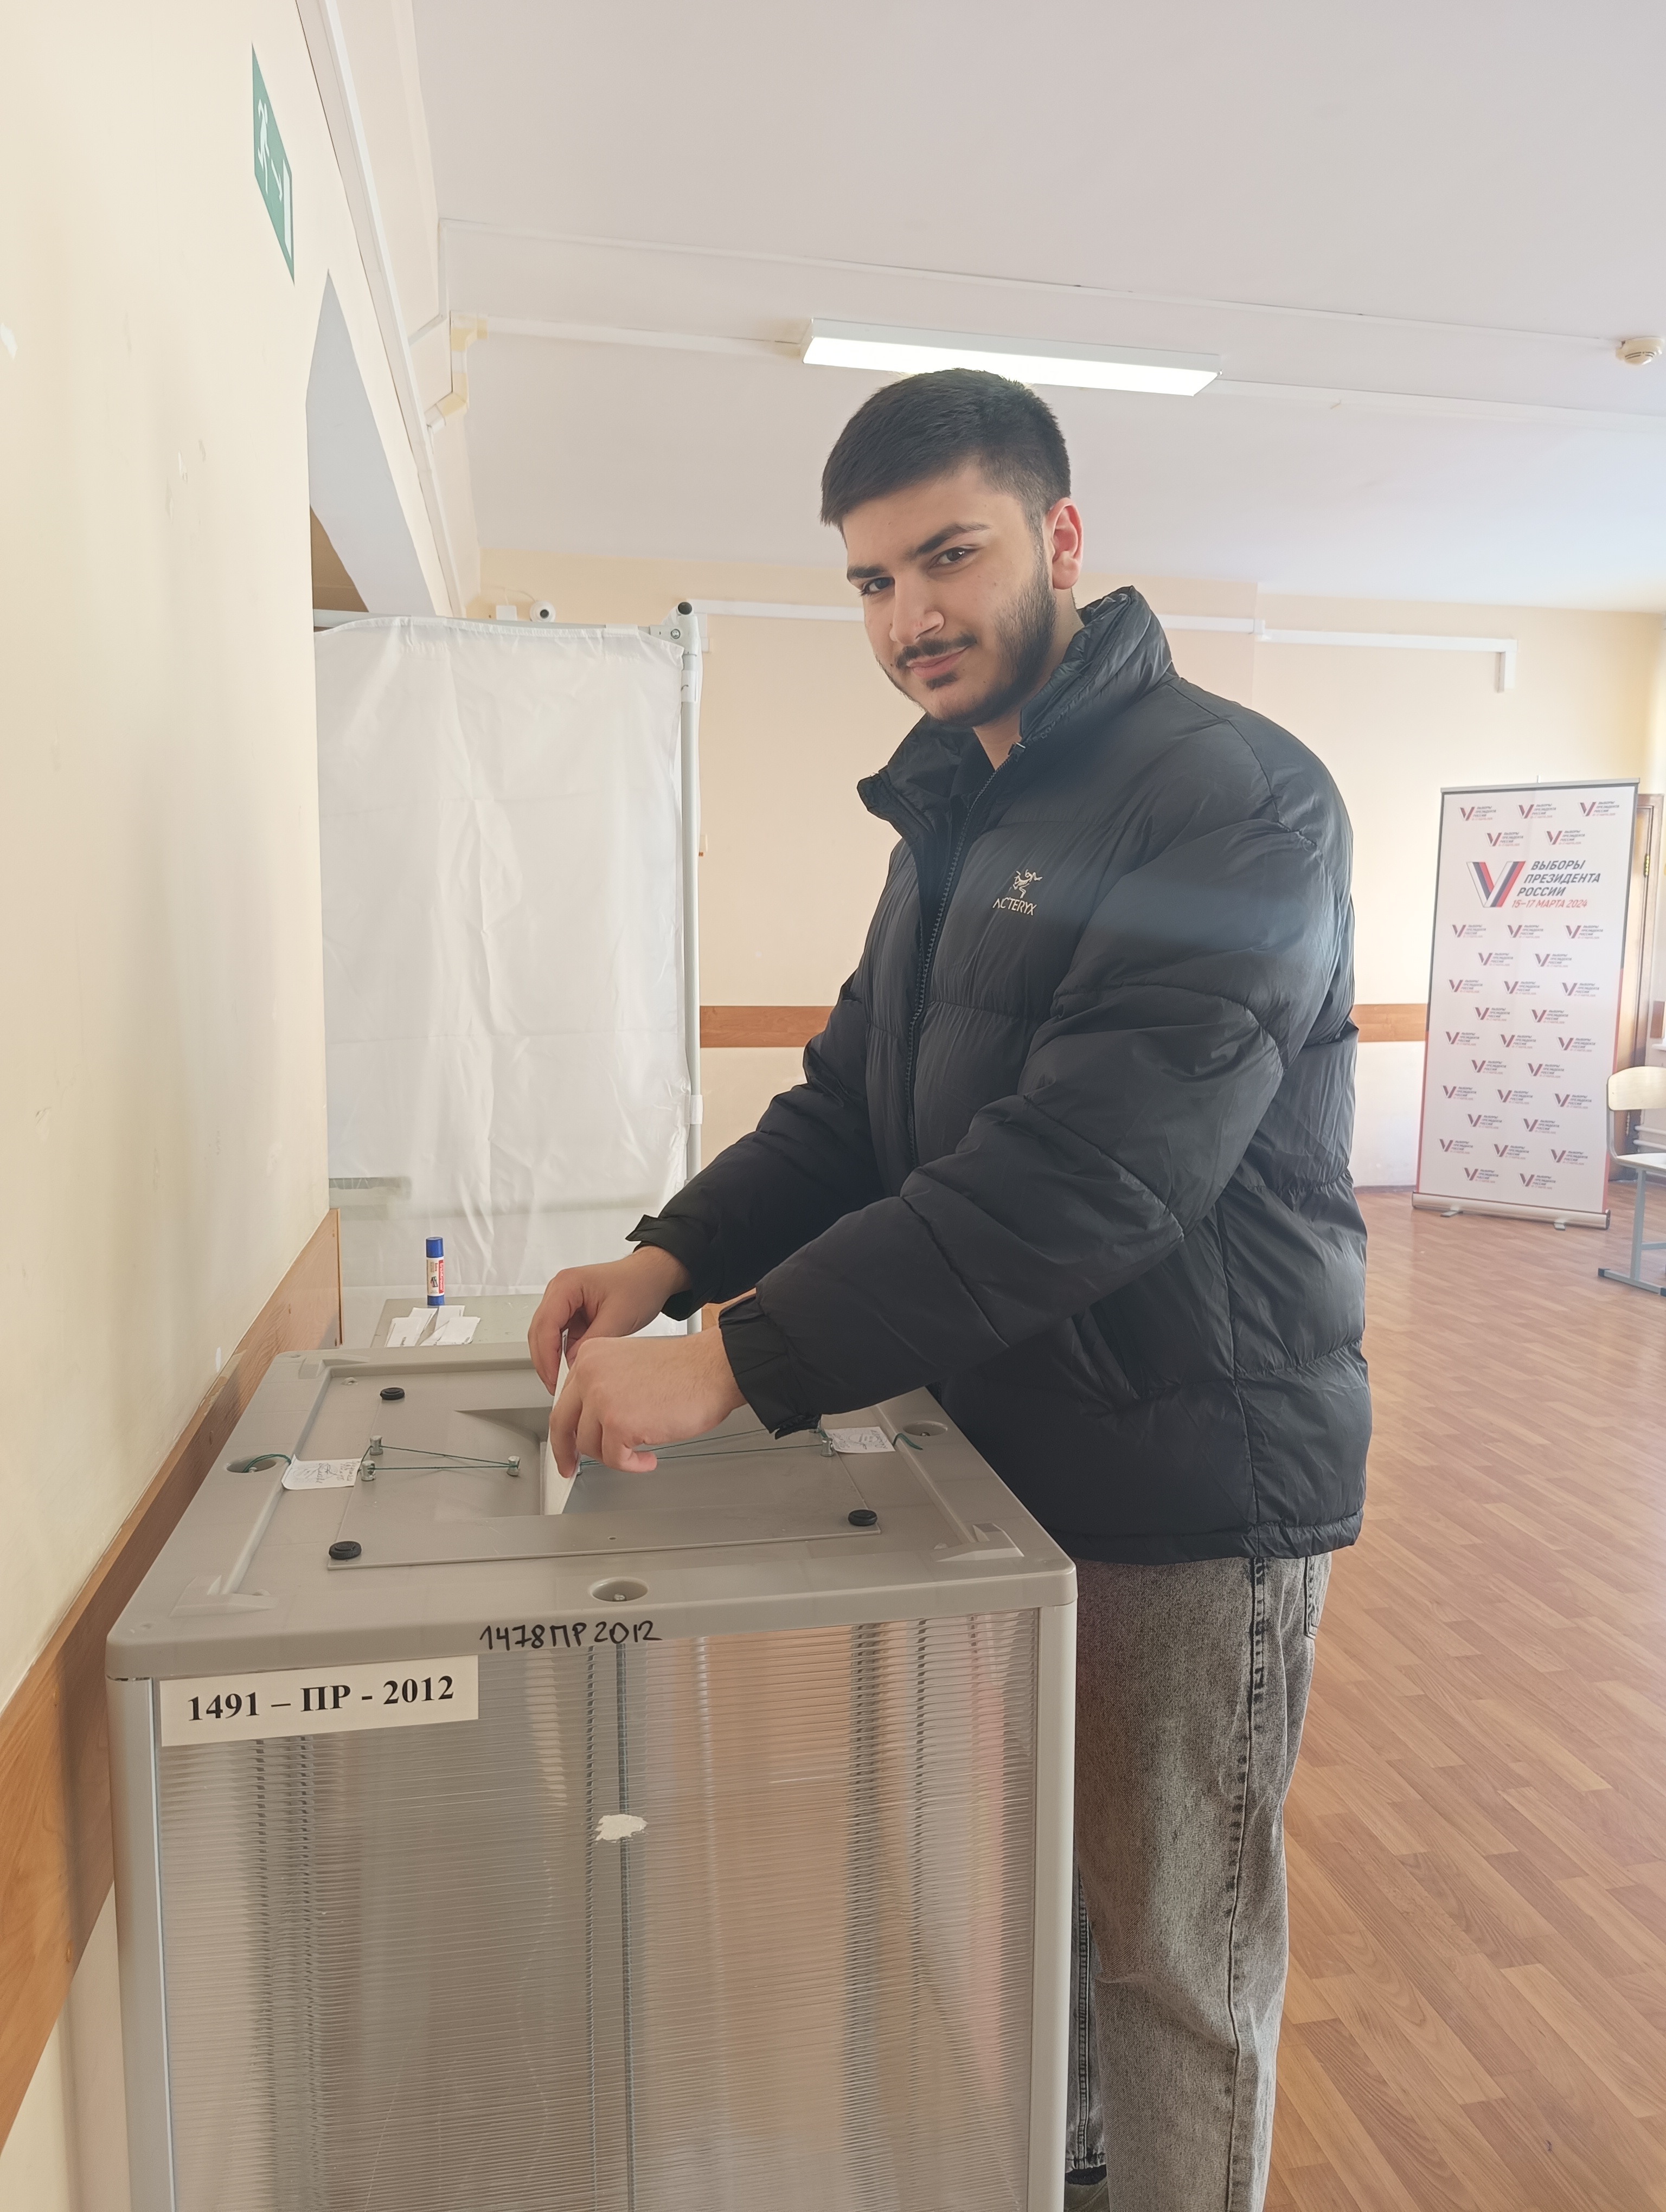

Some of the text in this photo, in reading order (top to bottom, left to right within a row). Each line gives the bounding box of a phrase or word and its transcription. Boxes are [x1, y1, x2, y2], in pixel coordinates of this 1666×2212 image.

[1531, 860, 1586, 871] ВЫБОРЫ
[1523, 873, 1601, 885] ПРЕЗИДЕНТА
[1517, 887, 1566, 897] РОССИИ
[1535, 899, 1565, 908] МАРТА
[1566, 899, 1588, 908] 2024
[188, 1692, 260, 1721] 1491
[300, 1684, 351, 1712] ПР
[383, 1675, 454, 1705] 2012
